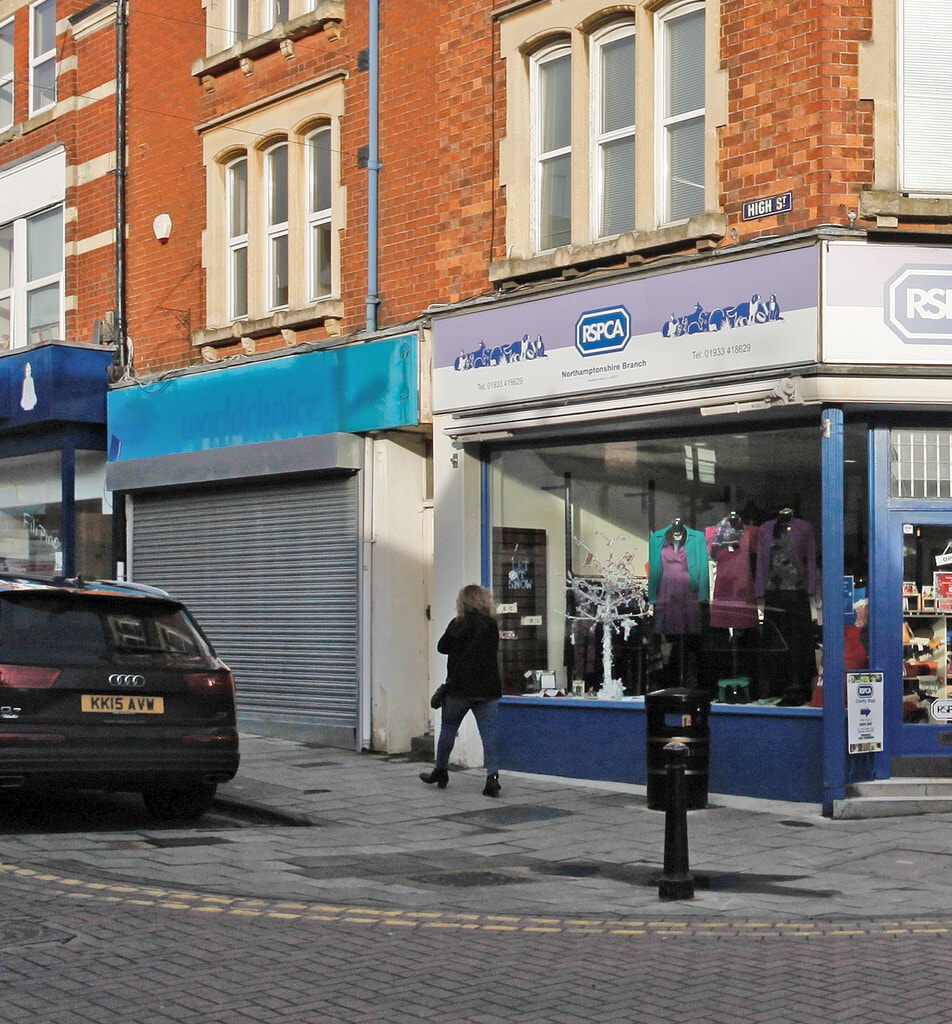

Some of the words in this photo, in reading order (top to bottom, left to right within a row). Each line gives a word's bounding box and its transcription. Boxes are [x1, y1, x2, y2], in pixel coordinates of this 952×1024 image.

[747, 199, 772, 217] HIGH
[582, 318, 625, 344] RSPCA
[704, 347, 726, 358] 01933
[727, 343, 752, 355] 418629
[561, 363, 621, 379] Northamptonshire
[622, 359, 647, 371] Branch
[508, 579, 533, 589] SNOW
[90, 696, 124, 711] KK15
[127, 698, 155, 711] AVW
